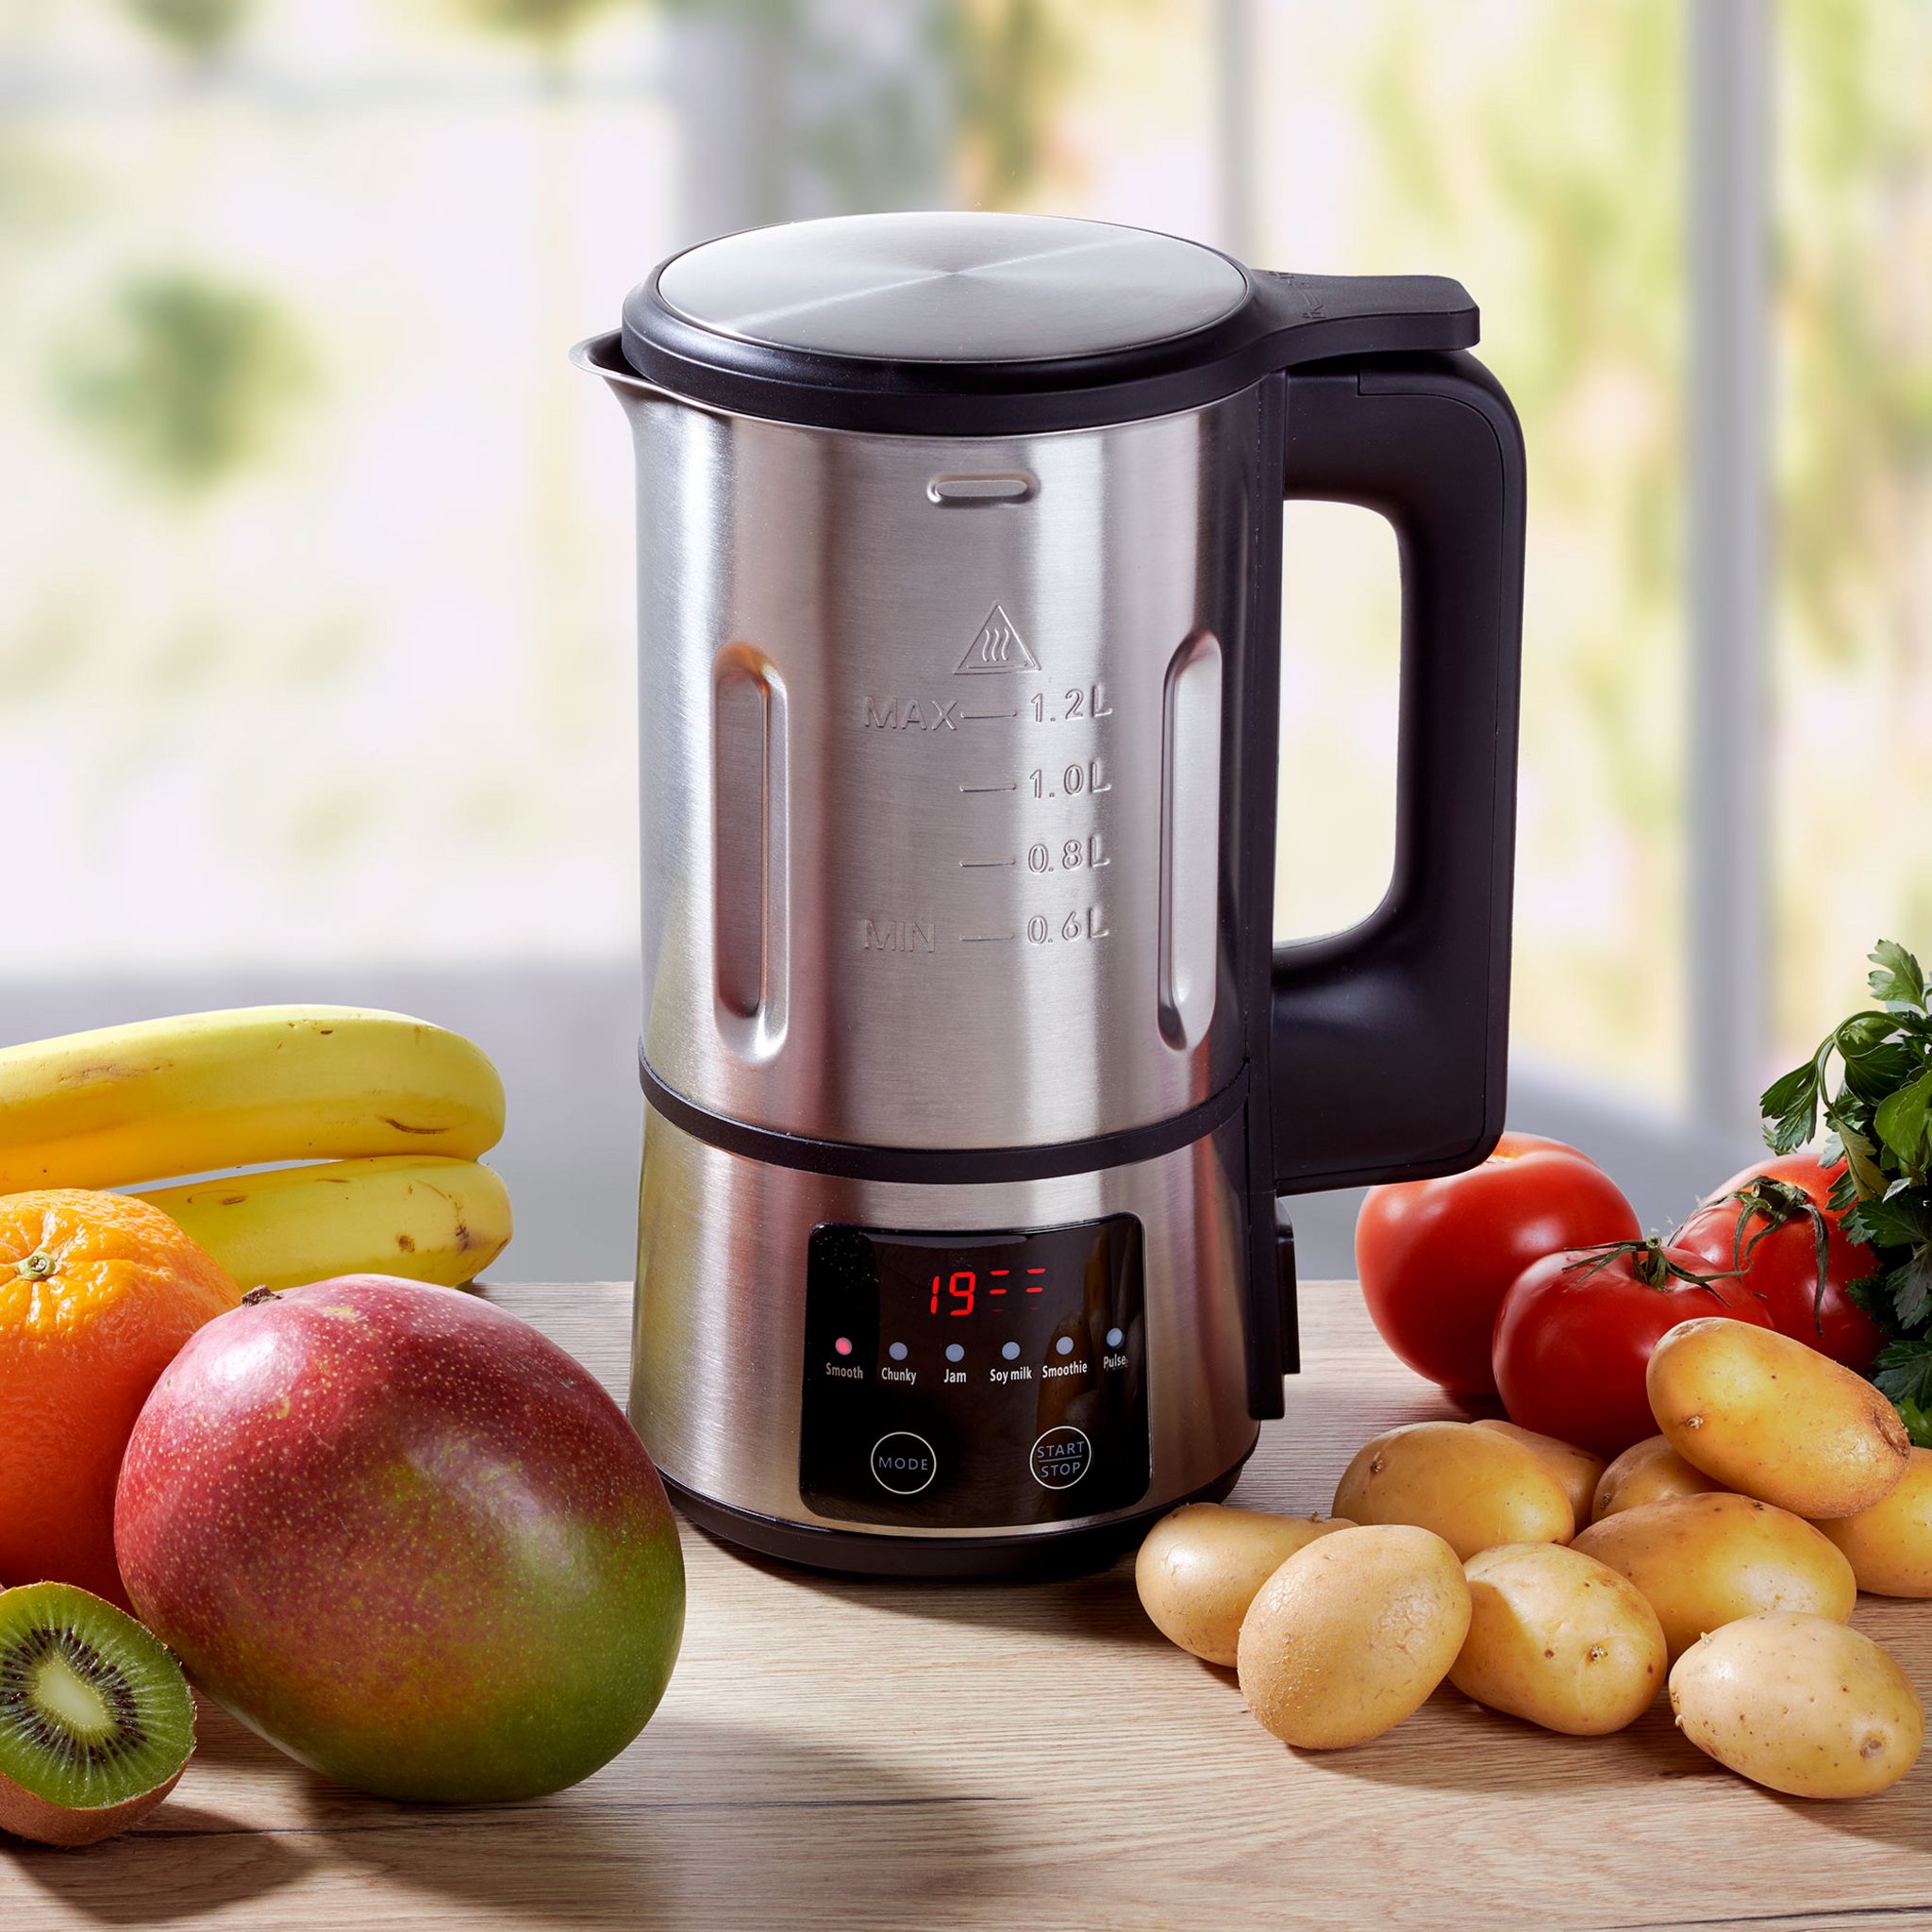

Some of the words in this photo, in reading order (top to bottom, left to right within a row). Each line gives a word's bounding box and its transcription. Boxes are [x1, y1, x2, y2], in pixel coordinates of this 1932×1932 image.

[862, 694, 958, 732] MAX
[862, 918, 937, 954] MIN
[825, 1362, 864, 1380] Smooth
[1041, 1361, 1088, 1379] Smoothie
[1103, 1354, 1127, 1370] Pulse
[881, 1367, 917, 1385] Chunky
[943, 1369, 967, 1383] Jam
[990, 1369, 1008, 1385] Soy
[1010, 1366, 1033, 1381] milk
[1037, 1441, 1086, 1459] START
[878, 1456, 929, 1472] MODE
[1040, 1461, 1081, 1478] STOP
